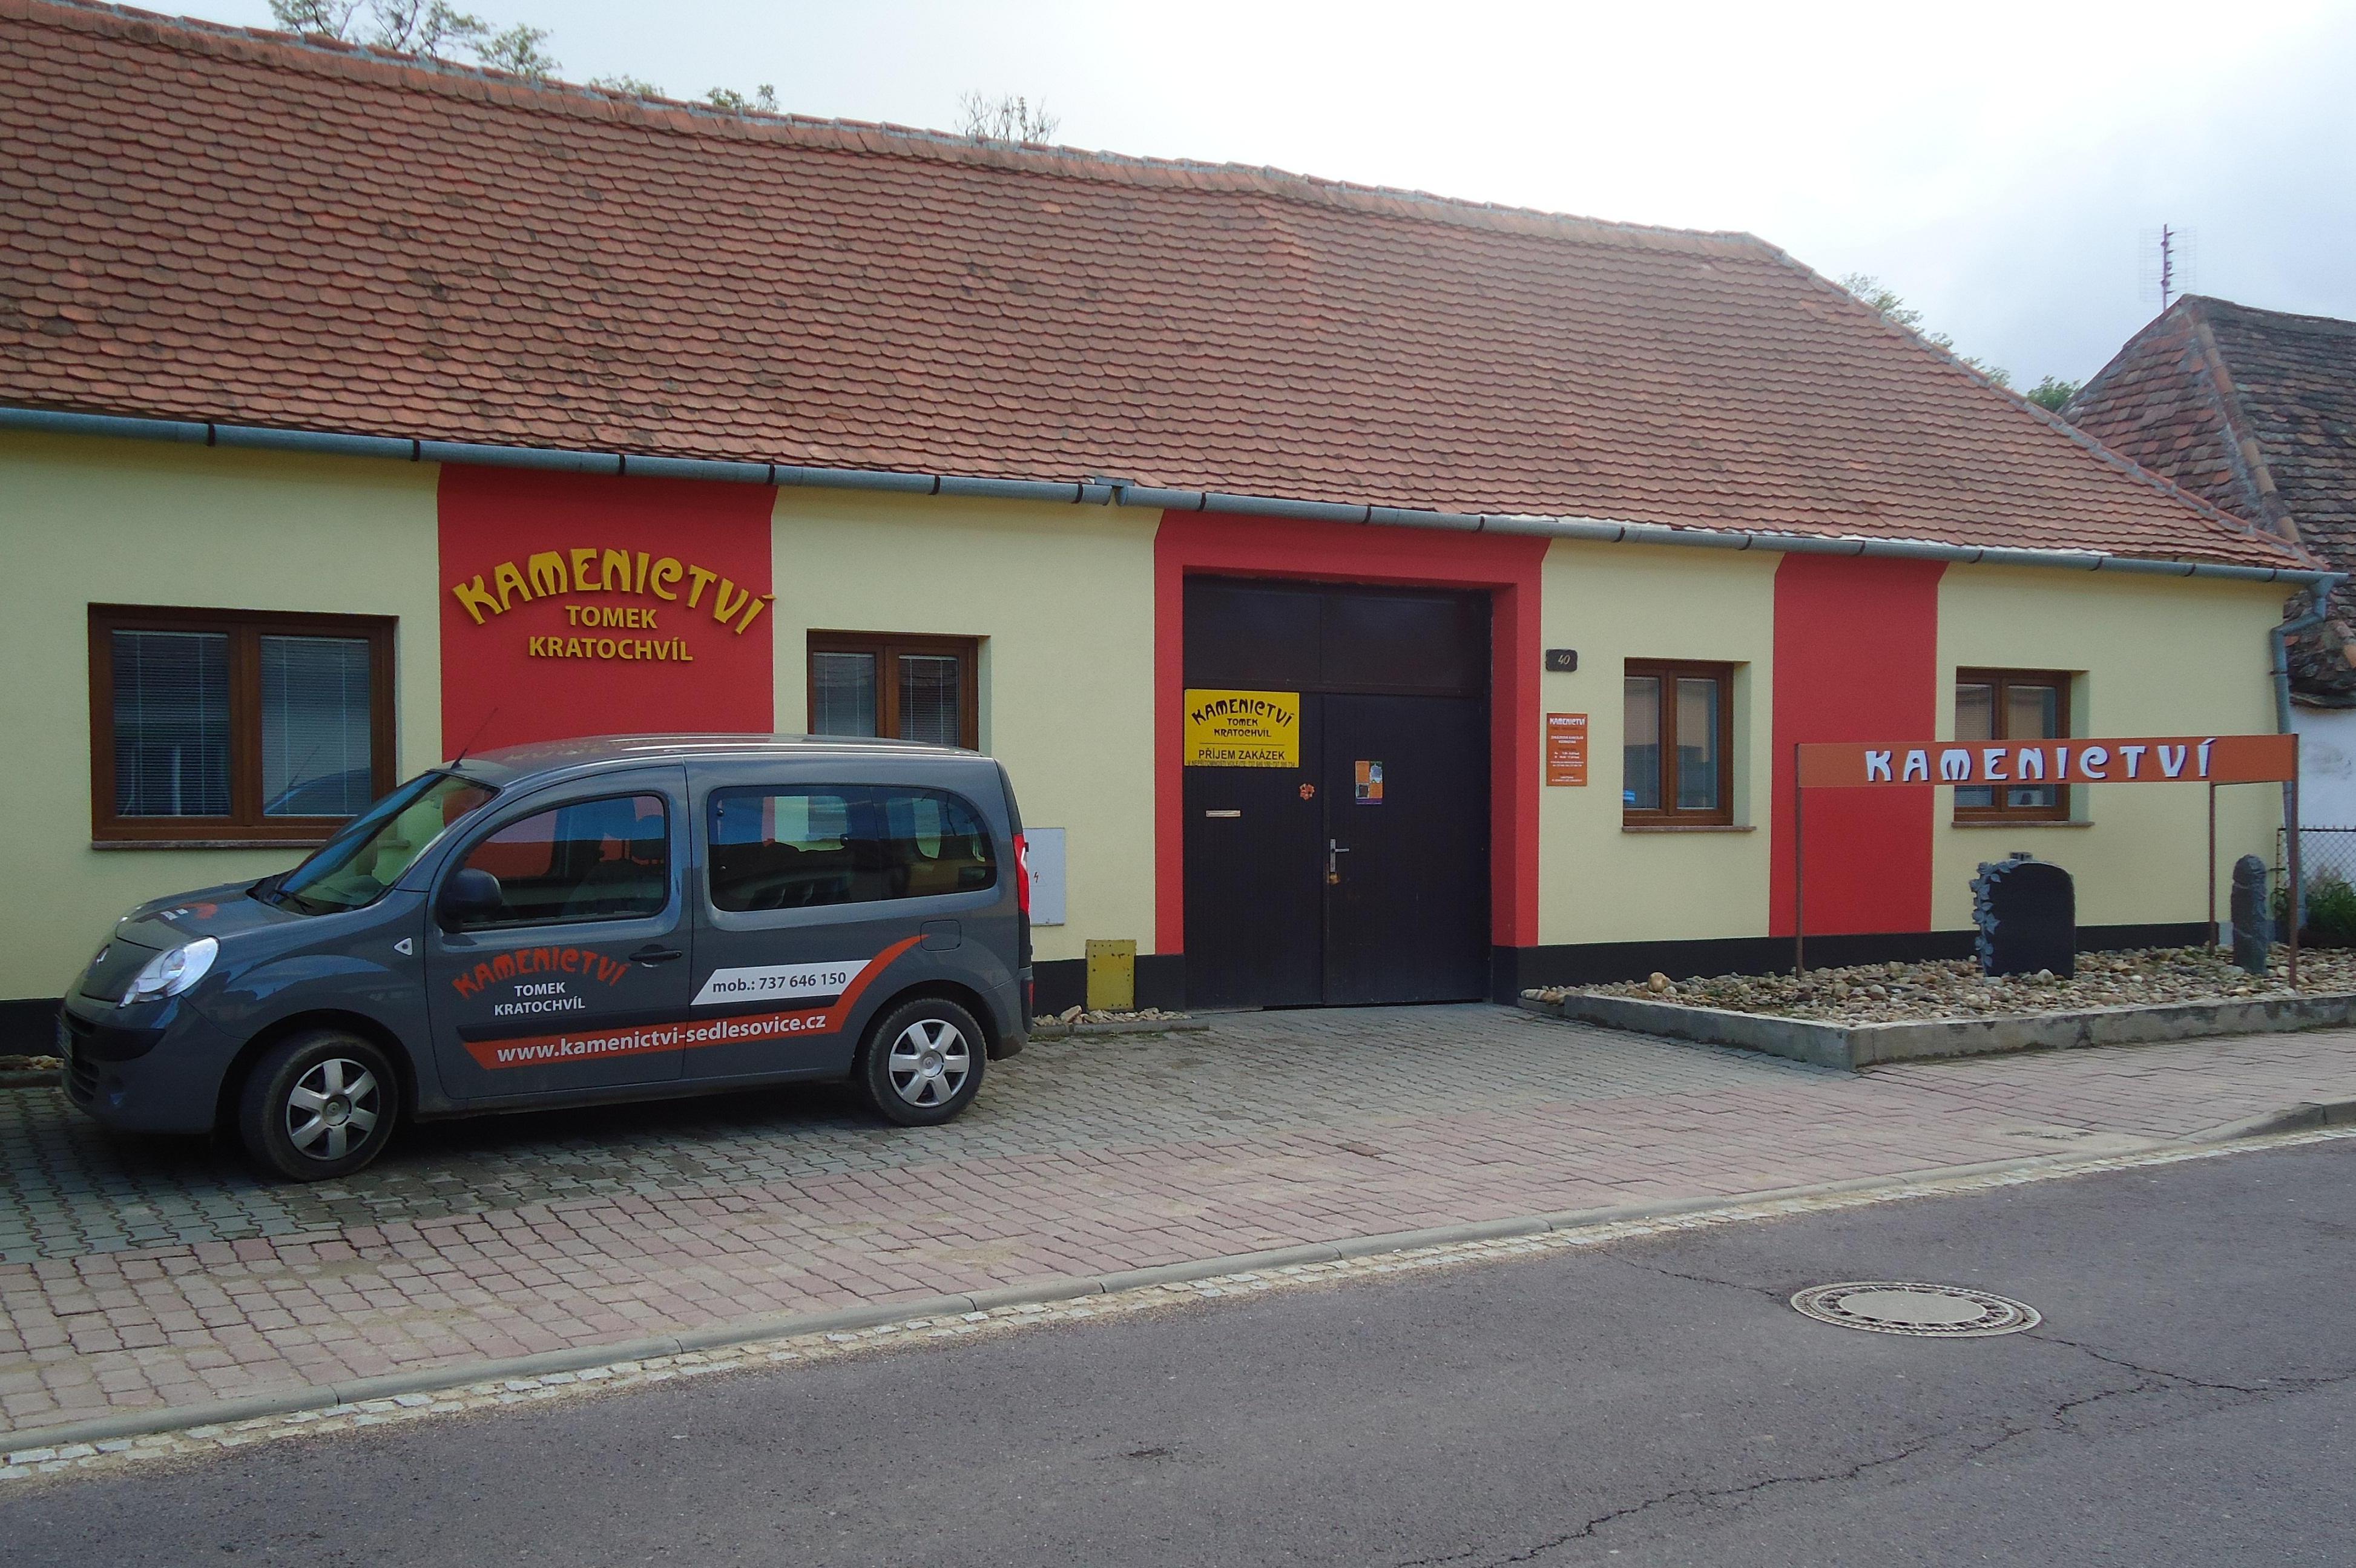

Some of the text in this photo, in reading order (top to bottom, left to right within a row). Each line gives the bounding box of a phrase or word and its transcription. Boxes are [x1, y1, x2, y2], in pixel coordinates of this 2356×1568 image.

[452, 548, 777, 635] KAMENICTVÍ
[565, 605, 658, 629] TOMEK
[528, 636, 693, 661] KRATOCHVÍL
[1558, 654, 1571, 665] 40
[1191, 699, 1295, 728] KAMENICTVÍ
[1227, 718, 1259, 726] TOMEK
[1214, 728, 1272, 737] KRATOCHVÍL
[1199, 748, 1285, 760] PŘÍJEM ZAKÁZEK
[1864, 737, 2217, 783] KAMENICTVÍ
[452, 946, 631, 999] KAMENICTVÍ
[712, 972, 846, 992] mob.: 737 646 150
[515, 982, 566, 997] TOMEK
[494, 996, 585, 1016] KRATOCHVÍL
[498, 1013, 826, 1062] www.kamenictvi-sedlesovice.cz
